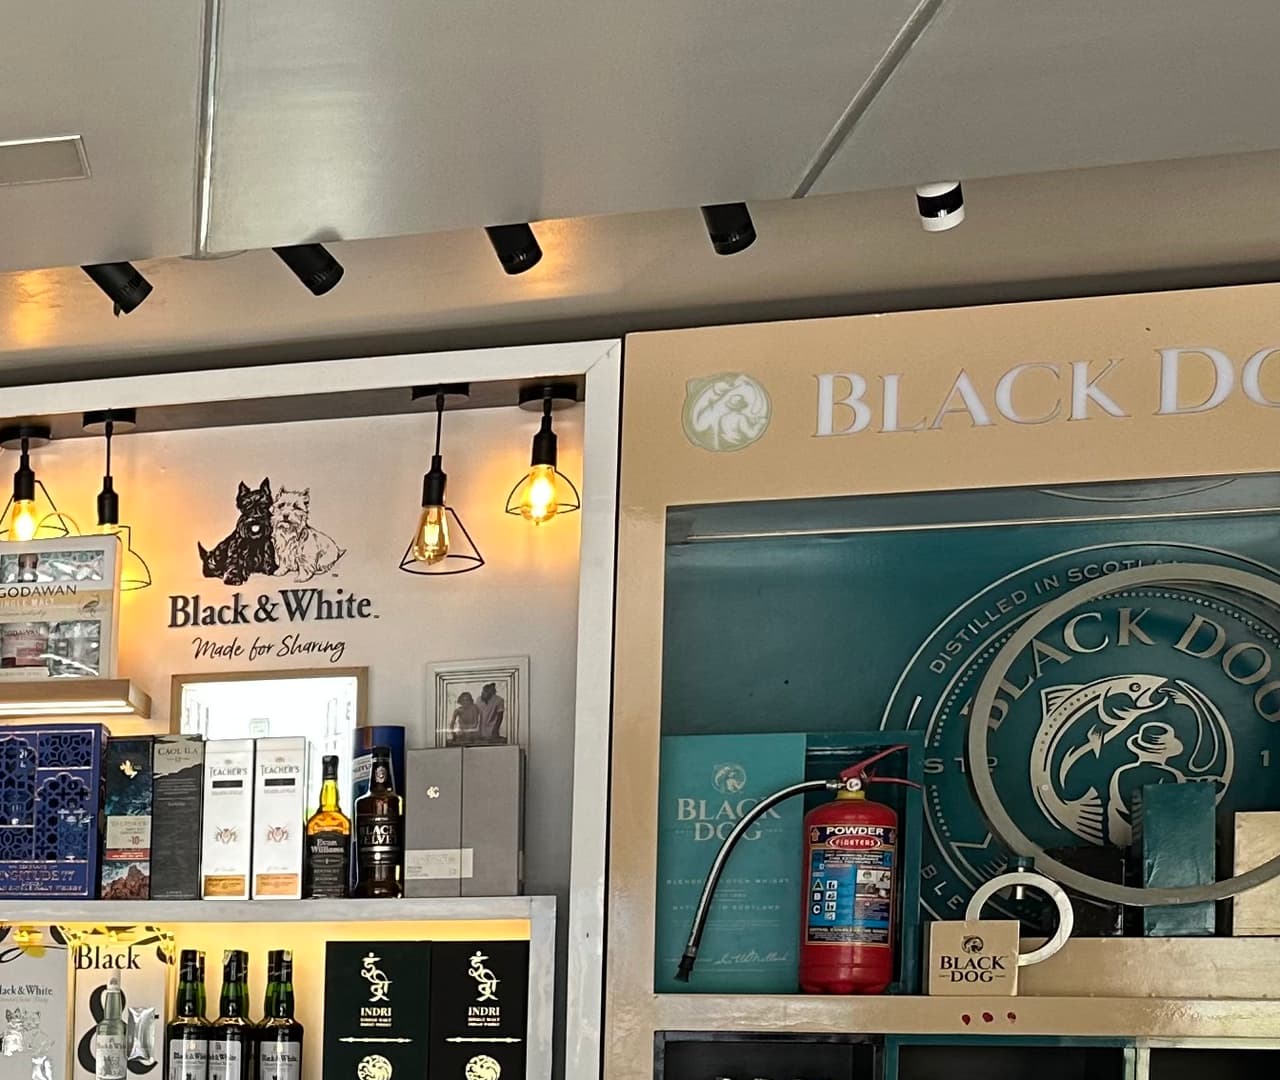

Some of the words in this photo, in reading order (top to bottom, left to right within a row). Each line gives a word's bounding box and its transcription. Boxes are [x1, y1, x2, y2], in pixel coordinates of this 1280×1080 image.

[811, 358, 1132, 438] BLACK
[1151, 346, 1280, 417] DO
[929, 589, 1028, 675] DISTILLED
[1035, 573, 1061, 595] IN
[192, 636, 244, 660] Made
[249, 636, 274, 661] for
[277, 633, 346, 664] Sharing
[209, 766, 248, 778] TEACHER'S
[261, 764, 300, 775] TEACHER'S
[826, 827, 884, 835] POWDER
[77, 945, 141, 969] Black
[940, 956, 1005, 970] BLACK
[950, 971, 994, 983] DOG
[360, 1007, 392, 1016] INDRI
[468, 1006, 500, 1016] INDRI
